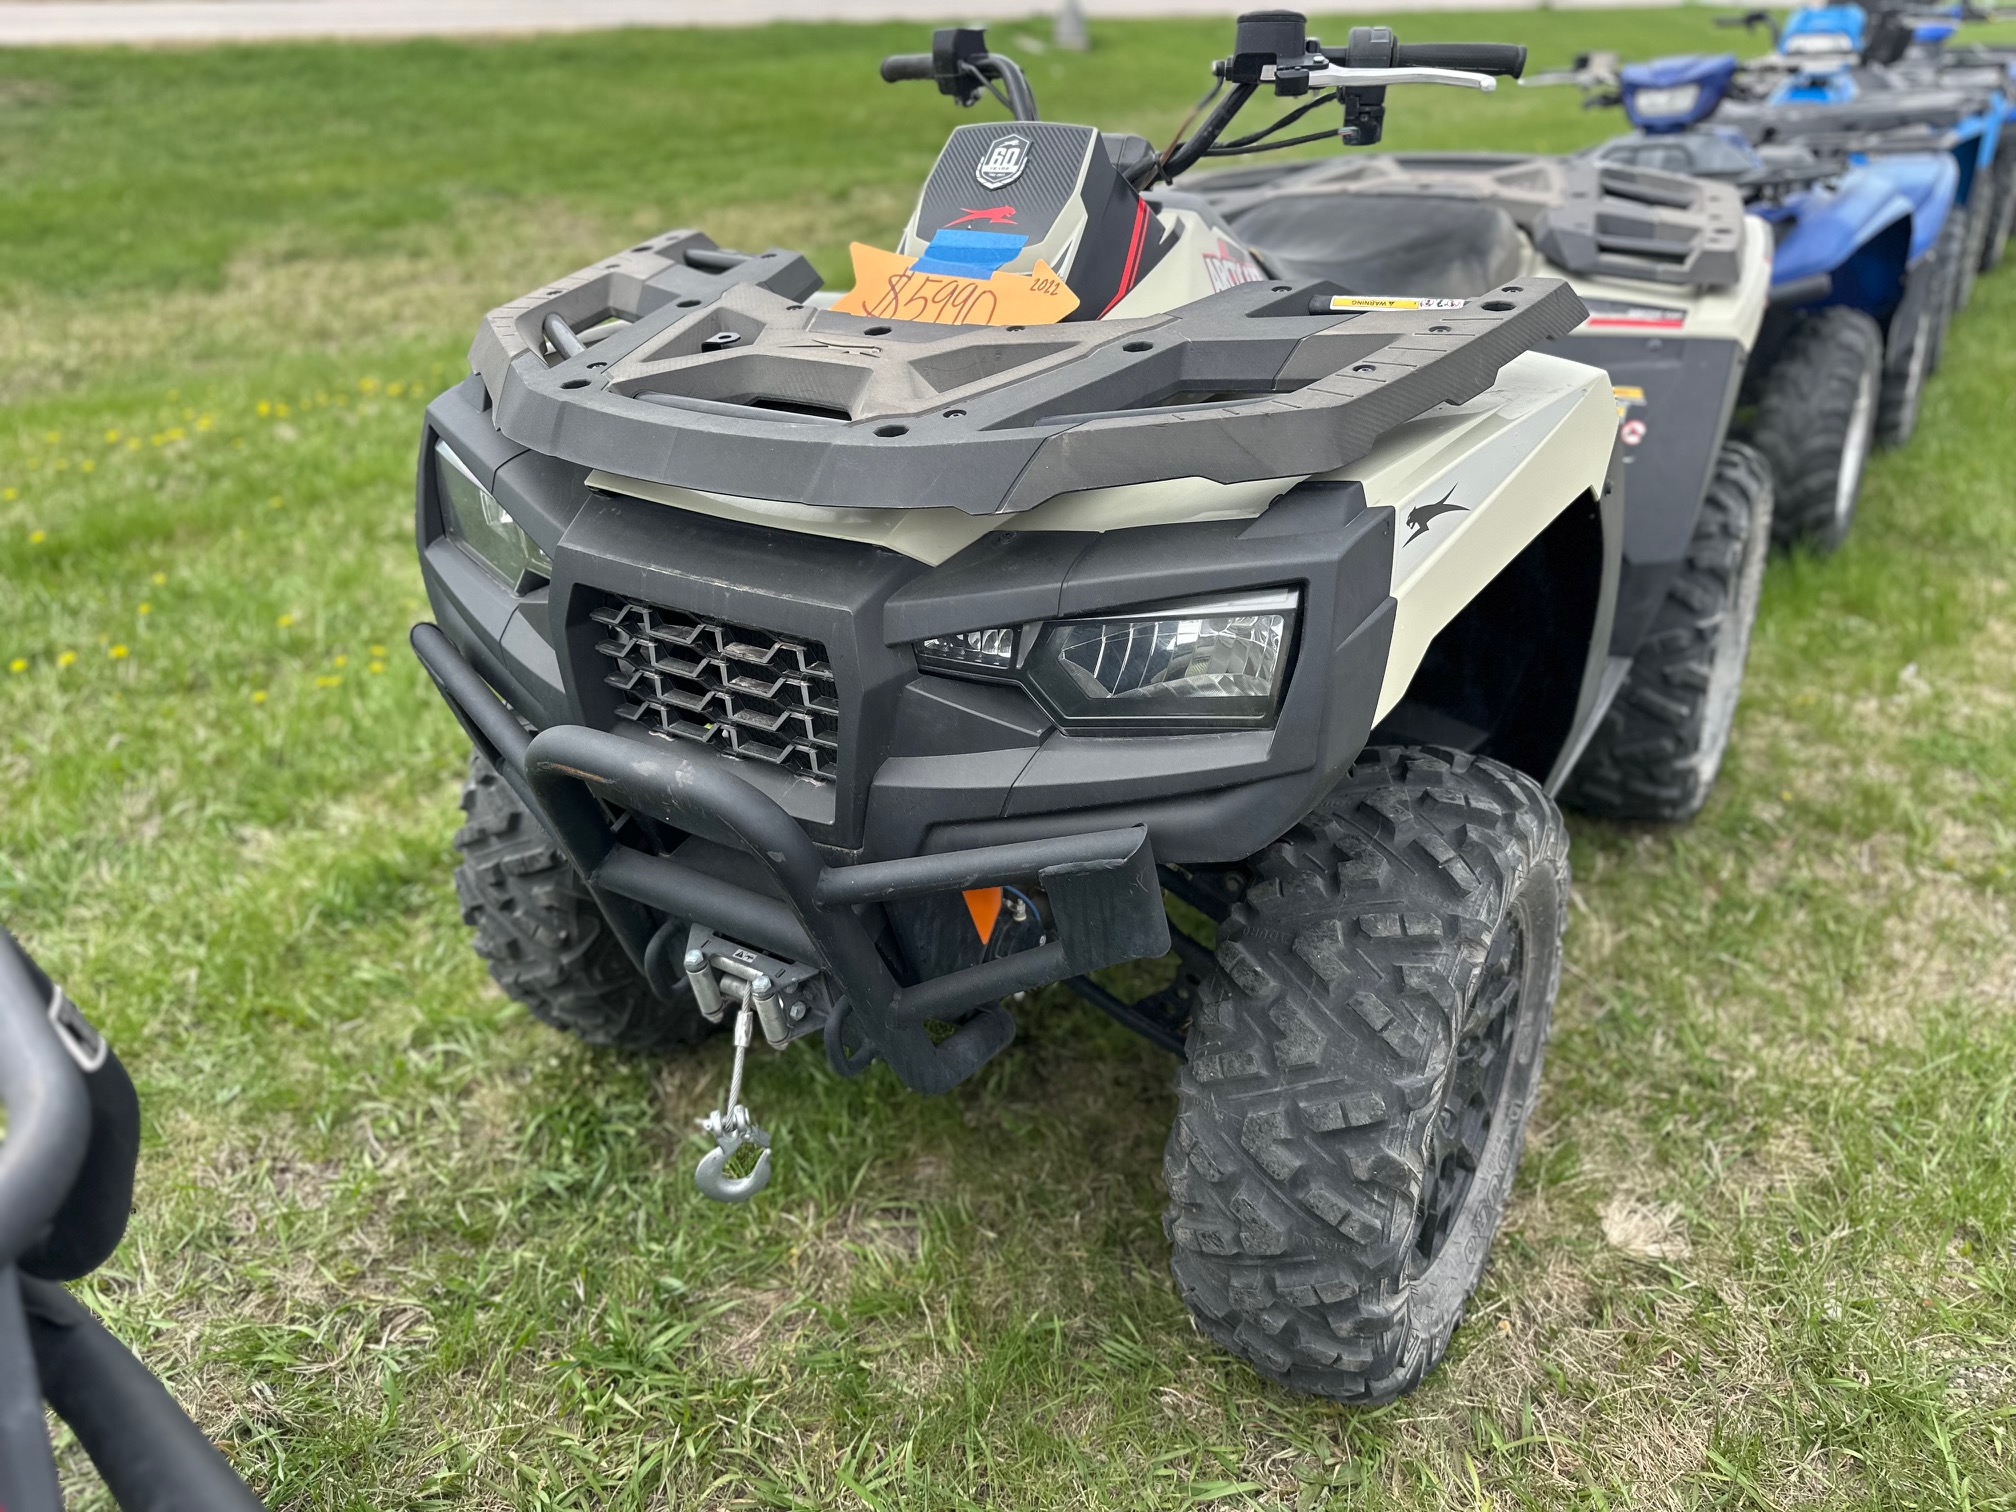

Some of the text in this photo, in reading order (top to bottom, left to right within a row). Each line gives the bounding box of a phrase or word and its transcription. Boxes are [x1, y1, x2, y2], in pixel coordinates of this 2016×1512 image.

[988, 147, 1020, 166] 60
[862, 266, 998, 325] $5990
[1029, 278, 1060, 296] 2022
[1351, 299, 1387, 307] WARNING
